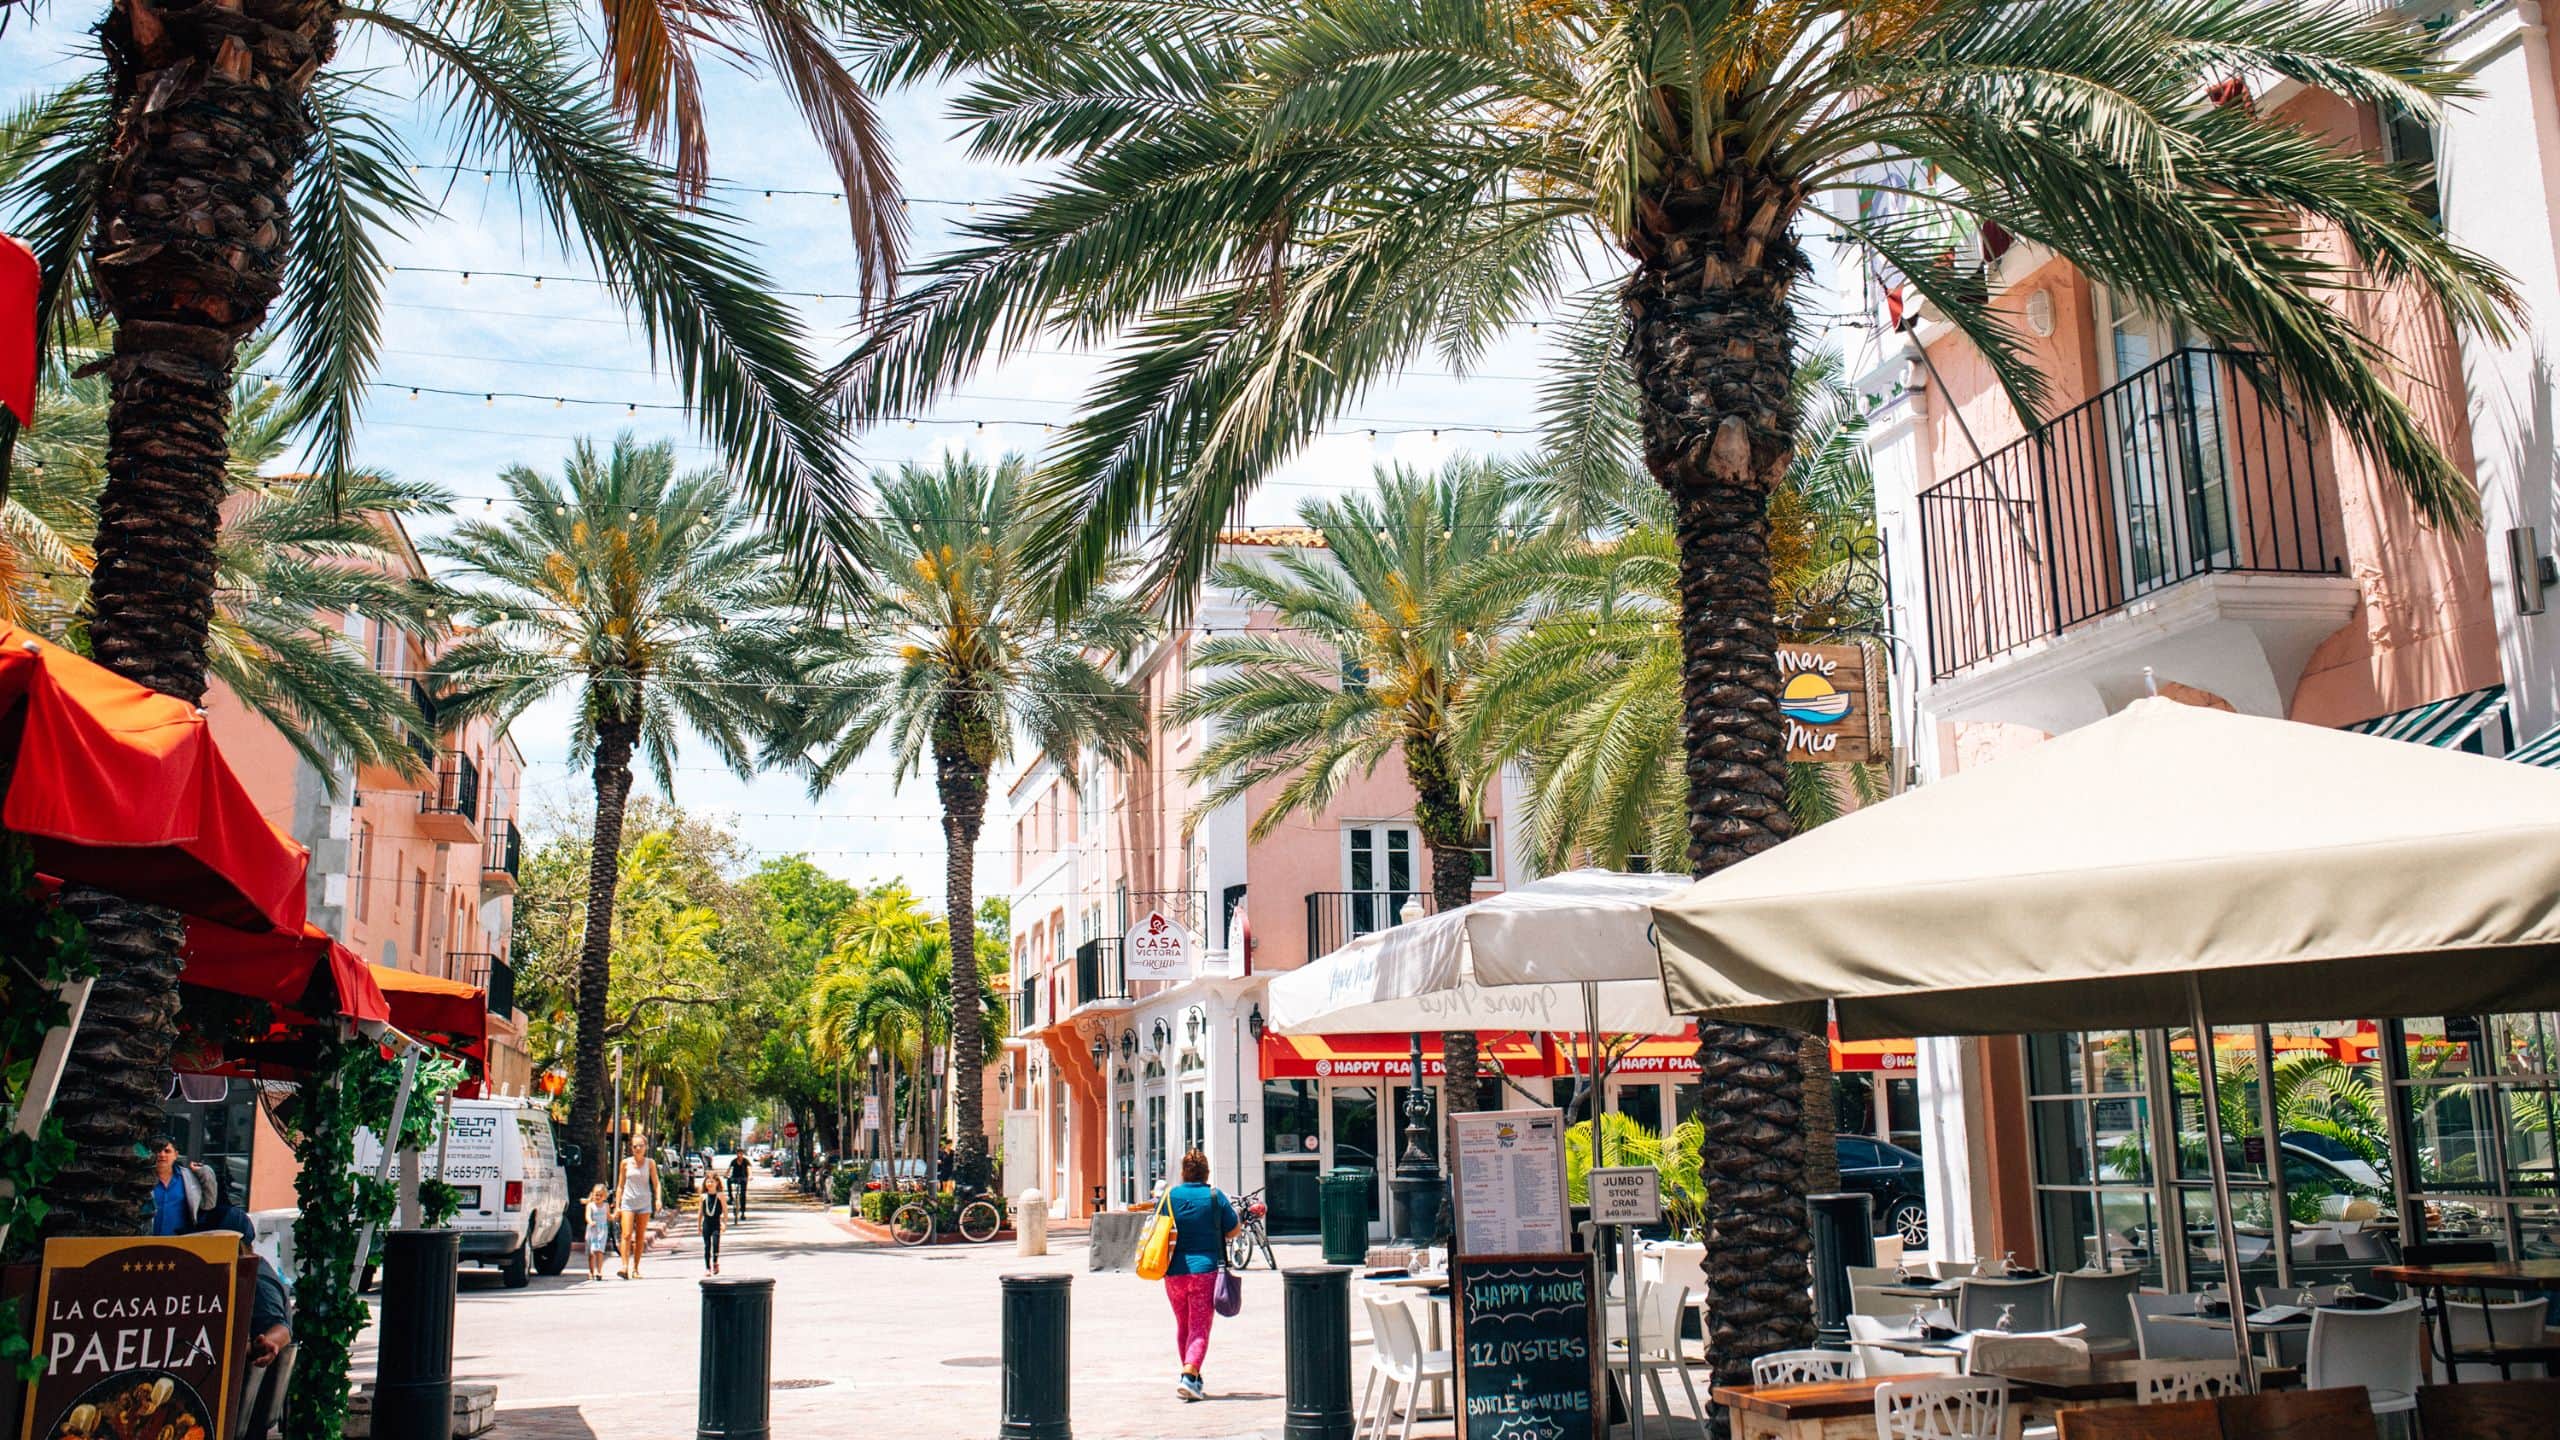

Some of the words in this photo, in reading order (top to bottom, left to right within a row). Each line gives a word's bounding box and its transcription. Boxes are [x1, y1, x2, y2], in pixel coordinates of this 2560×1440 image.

[1775, 650, 1838, 682] Mare
[1781, 719, 1839, 755] Mio
[1136, 937, 1181, 948] CASA
[1142, 960, 1175, 969] ORCHID
[1334, 1061, 1380, 1073] HAPPY
[1384, 1061, 1428, 1073] PLAE
[1621, 1057, 1665, 1070] HAPPY
[449, 1128, 491, 1137] TECH
[432, 1166, 499, 1178] 94-665-9775
[1603, 1176, 1644, 1186] JUMBO
[1608, 1189, 1640, 1197] STONE
[1474, 1283, 1534, 1310] HAPPY
[1539, 1281, 1585, 1302] HOUR
[52, 1300, 84, 1321] LA
[92, 1297, 157, 1319] CASA
[165, 1295, 191, 1316] DE
[197, 1294, 223, 1314] LA
[47, 1325, 217, 1376] PAELLA
[1470, 1343, 1497, 1367] 12
[1501, 1337, 1585, 1366] OYSTERS
[1468, 1394, 1520, 1416] BOTTLE
[1538, 1391, 1589, 1411] WINE
